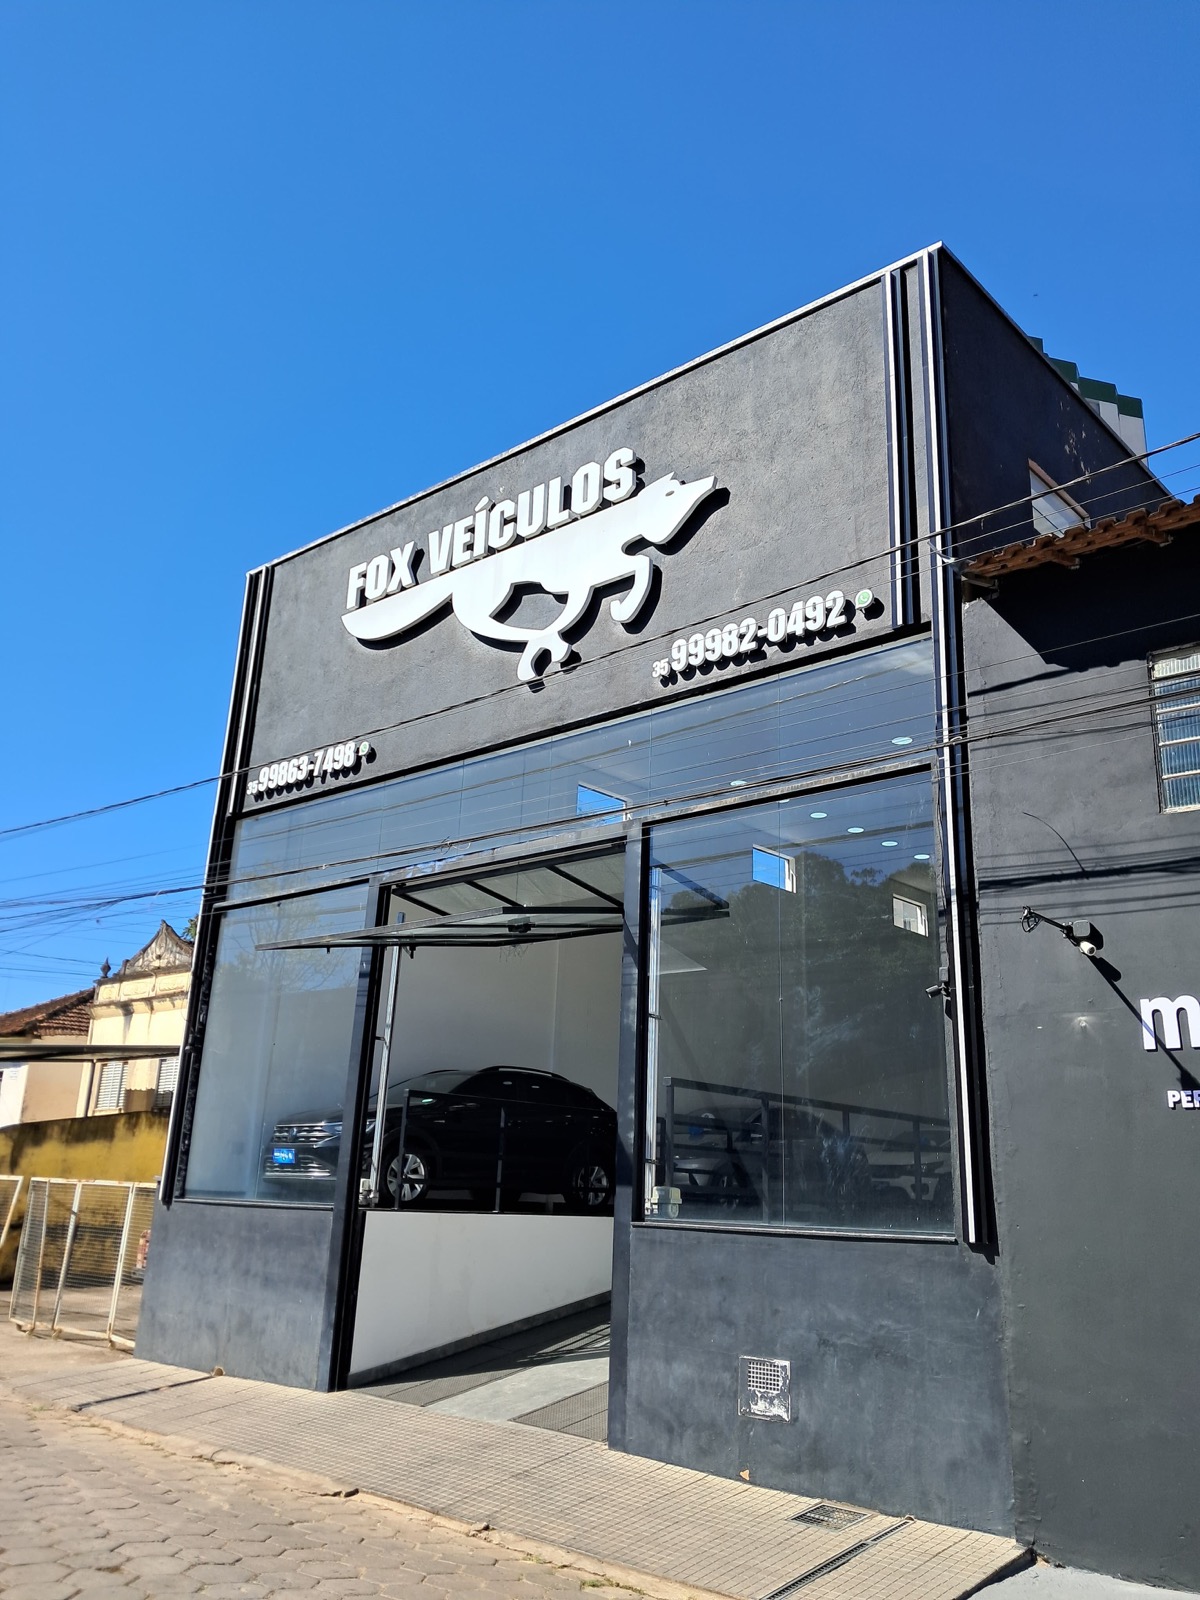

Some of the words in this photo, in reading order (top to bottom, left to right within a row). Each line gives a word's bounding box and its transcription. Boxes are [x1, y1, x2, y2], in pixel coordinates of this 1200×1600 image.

[346, 541, 418, 609] FOX
[428, 446, 638, 576] VEÍCULOS
[652, 658, 670, 678] 35
[671, 590, 848, 671] 99982-0492
[246, 780, 259, 795] 35
[258, 741, 356, 792] 99863-7498
